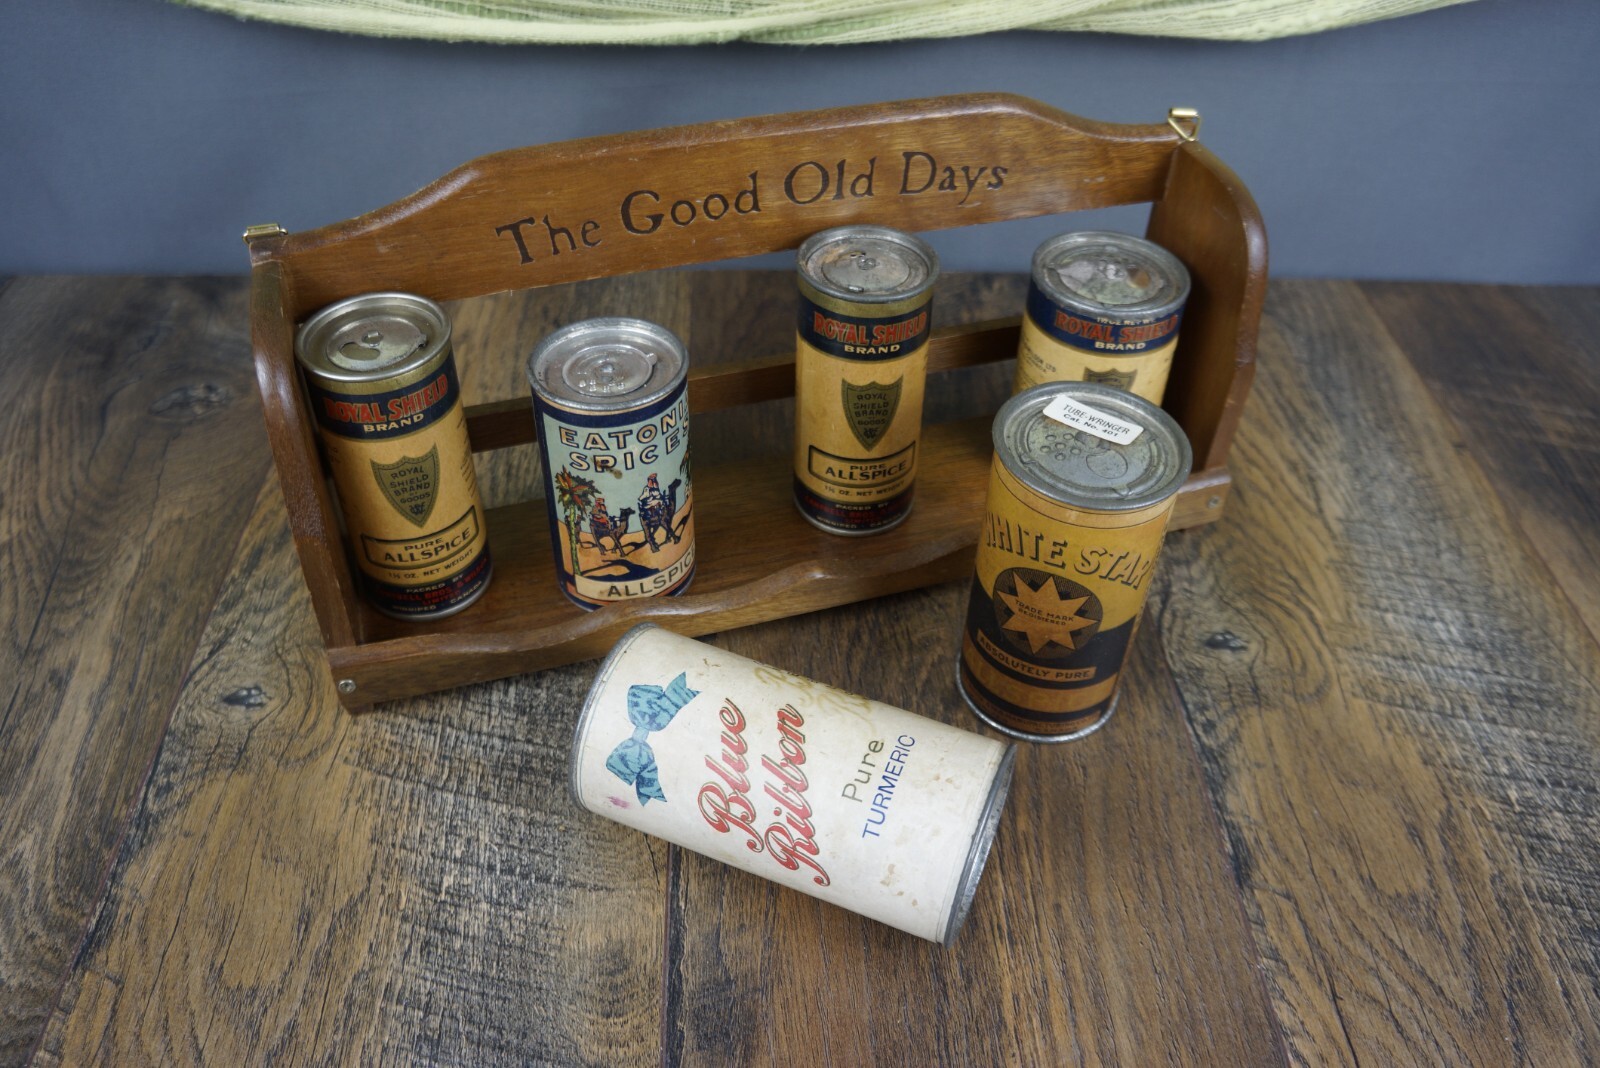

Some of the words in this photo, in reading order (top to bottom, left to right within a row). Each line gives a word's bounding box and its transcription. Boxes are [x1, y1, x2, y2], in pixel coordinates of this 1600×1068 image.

[496, 216, 602, 265] The
[621, 171, 762, 235] Good
[784, 157, 877, 204] Old
[899, 151, 1008, 206] Days
[813, 311, 869, 345] ROYAL
[872, 311, 927, 345] SHIELD
[1055, 309, 1115, 342] ROYAL
[1120, 314, 1178, 343] SHIELD
[844, 344, 900, 355] BRAND
[1094, 341, 1146, 350] BRAND
[323, 396, 387, 424] ROYAL
[387, 374, 449, 421] SHIELD
[853, 402, 889, 410] SHIELD
[856, 393, 887, 401] ROYAL
[363, 413, 424, 433] BRAND
[559, 391, 689, 450] EATONI
[855, 409, 889, 417] BRAND
[1063, 404, 1131, 434] TUBE-WRINGER
[1063, 413, 1081, 423] Cal.
[1084, 421, 1099, 431] No.
[1102, 429, 1118, 437] 401
[390, 465, 425, 479] ROYAL
[390, 474, 429, 488] SHIELD
[825, 460, 907, 481] ALLSPICE
[394, 482, 430, 496] BRAND
[400, 492, 430, 503] GOODS
[835, 503, 872, 511] PACKED
[384, 527, 471, 563] ALLSPICE
[404, 537, 443, 551] PURE
[423, 568, 441, 576] NET
[444, 548, 474, 570] WEIGHT
[406, 582, 446, 593] PACKED
[1015, 599, 1043, 614] TRADE
[1046, 612, 1074, 622] MARK
[1018, 608, 1067, 626] REGISTERED
[980, 636, 1050, 677] ABSOLUTELY
[1055, 670, 1090, 679] PURE
[697, 697, 764, 853] Blue
[841, 738, 885, 803] Pure
[760, 703, 830, 887] Ribbon
[862, 734, 916, 839] TURMERIC
